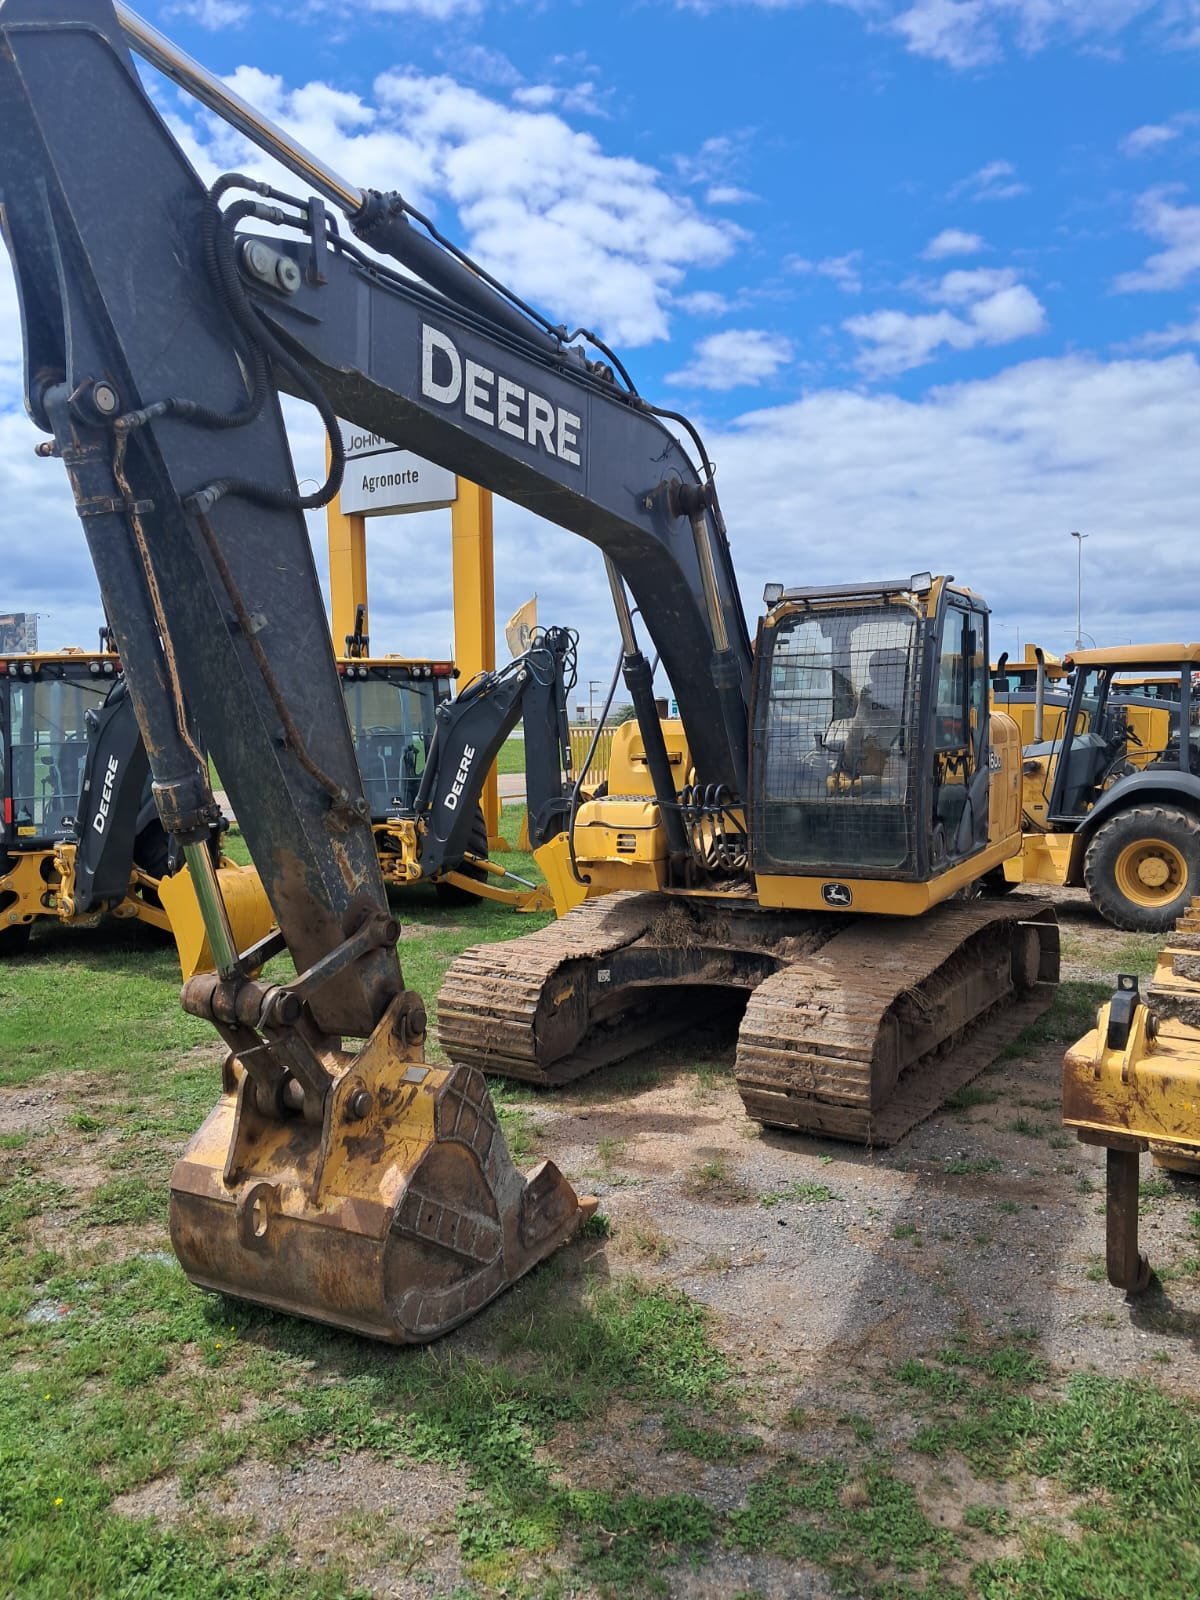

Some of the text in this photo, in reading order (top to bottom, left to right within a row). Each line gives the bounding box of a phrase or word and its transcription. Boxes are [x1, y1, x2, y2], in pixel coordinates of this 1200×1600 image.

[422, 323, 581, 466] DEERE
[348, 433, 381, 450] JOHN
[362, 469, 419, 493] Agronorte
[93, 754, 119, 835] DEERE
[443, 744, 475, 810] DEERE
